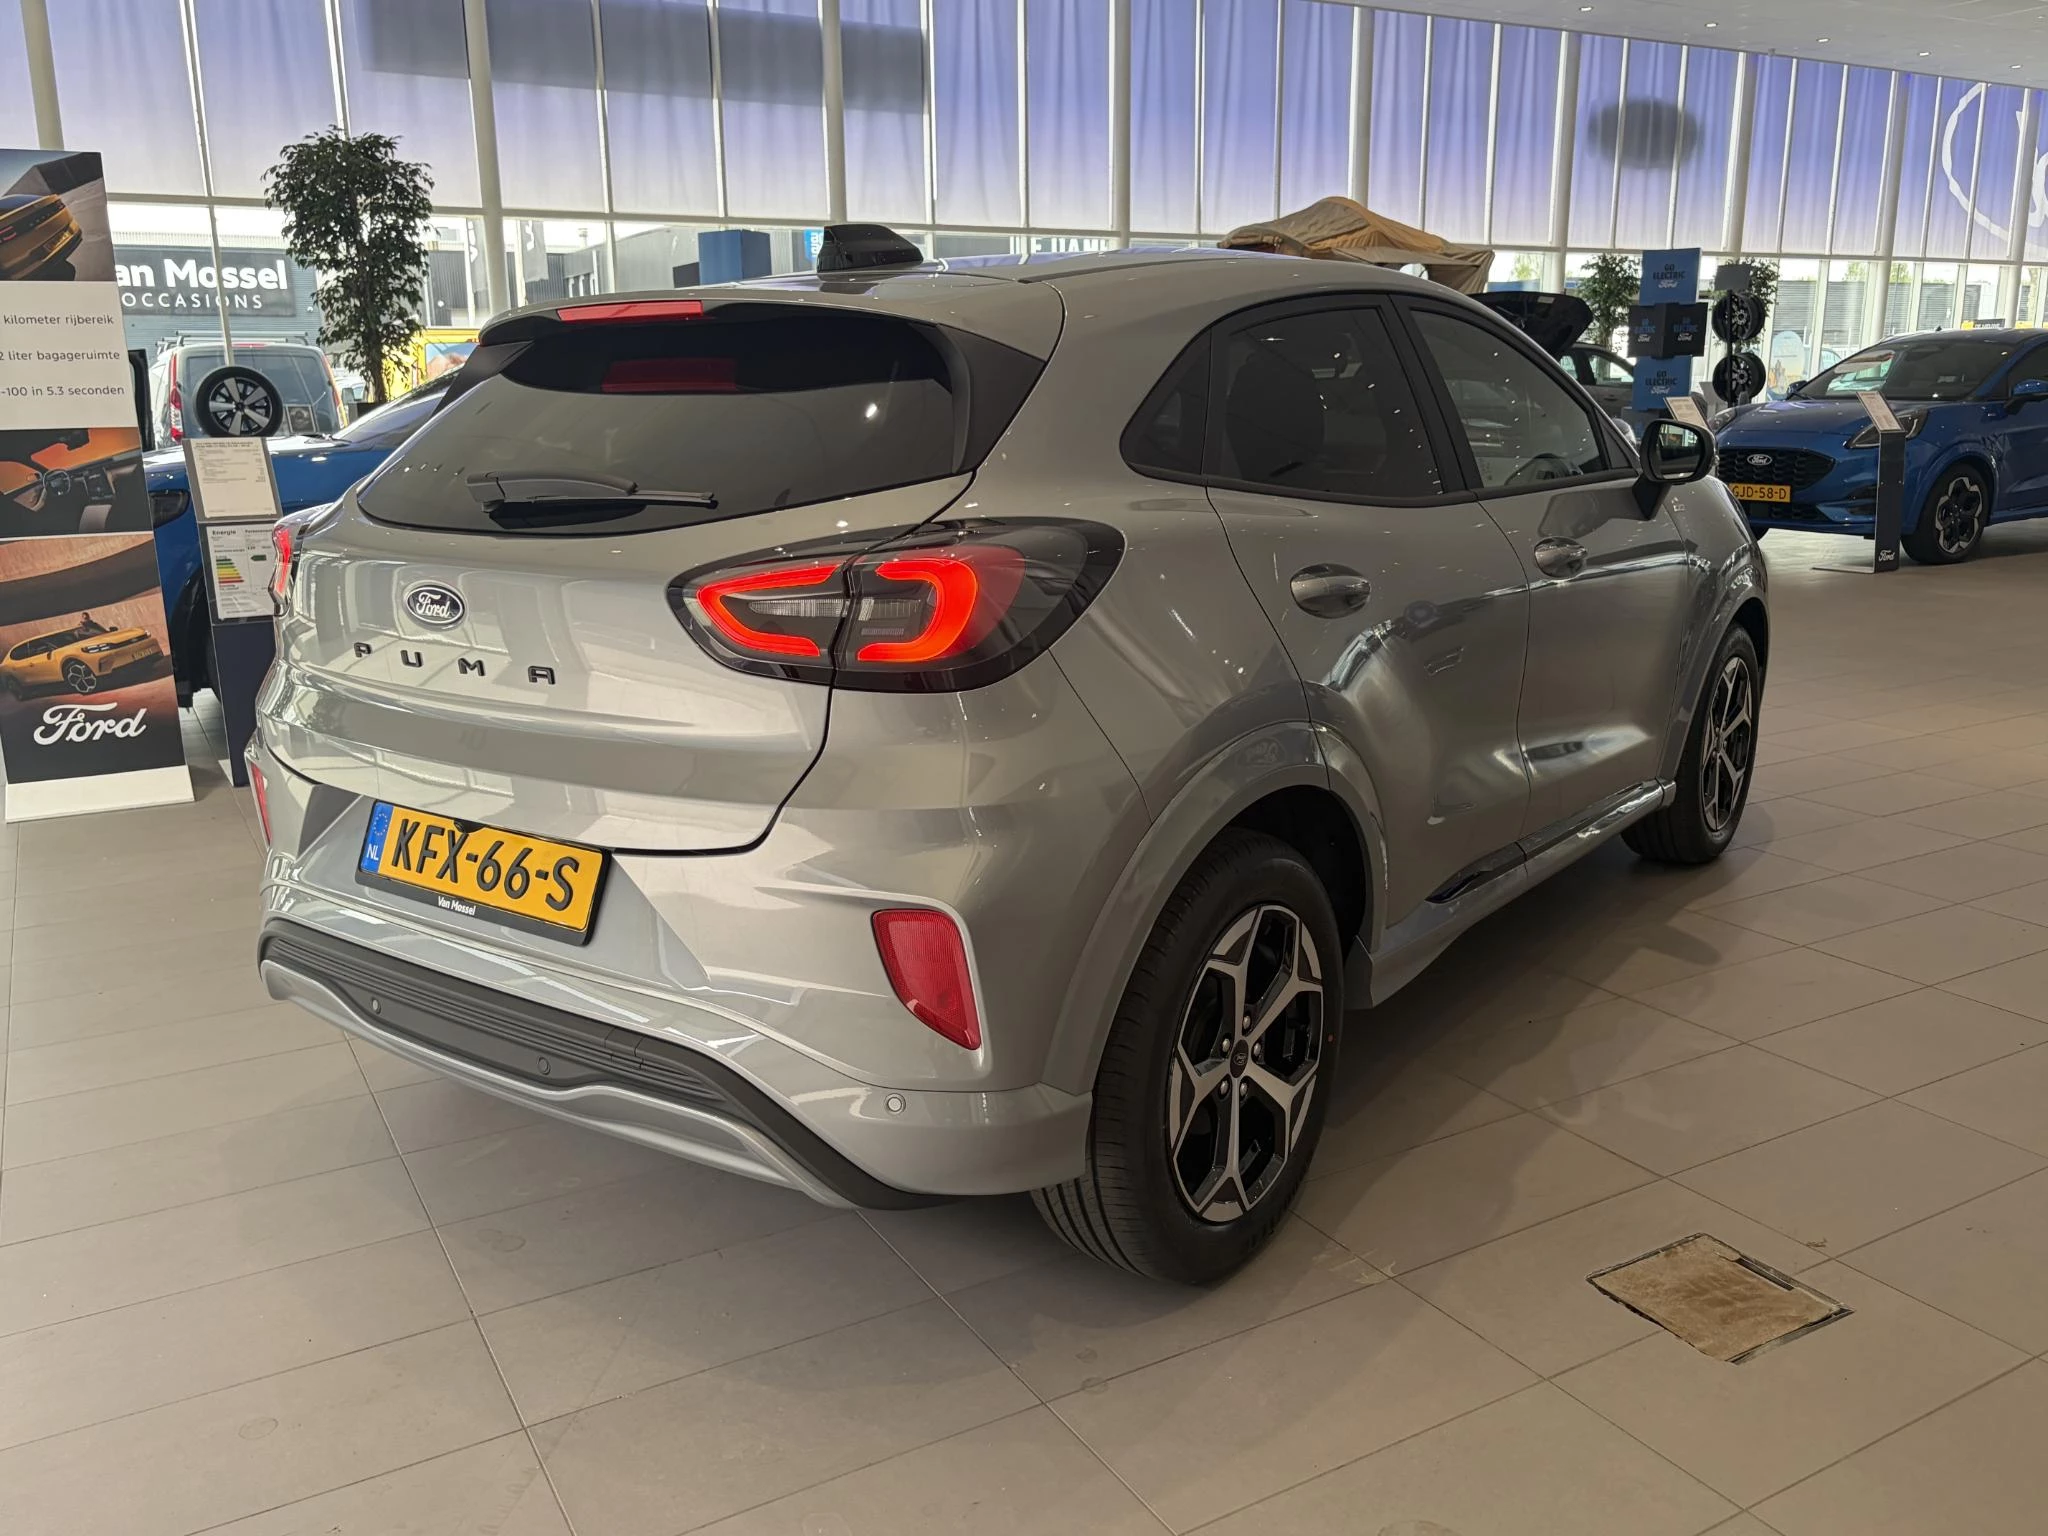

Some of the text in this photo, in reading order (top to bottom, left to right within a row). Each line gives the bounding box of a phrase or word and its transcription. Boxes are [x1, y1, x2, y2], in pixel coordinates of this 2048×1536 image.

[115, 259, 288, 290] an Mossel
[121, 292, 262, 309] OCCASIONS
[4, 315, 114, 326] kilometer rijbereik
[8, 351, 32, 360] liter
[37, 350, 120, 362] bagageruimte
[1, 386, 125, 396] -100 in 5.3 seconden
[1879, 550, 1895, 561] Ford
[415, 591, 452, 619] Ford
[354, 641, 556, 685] PUMA
[33, 702, 148, 746] Ford
[366, 843, 380, 862] NL
[391, 818, 580, 913] KFX-66-S
[437, 896, 477, 917] Van Mossel
